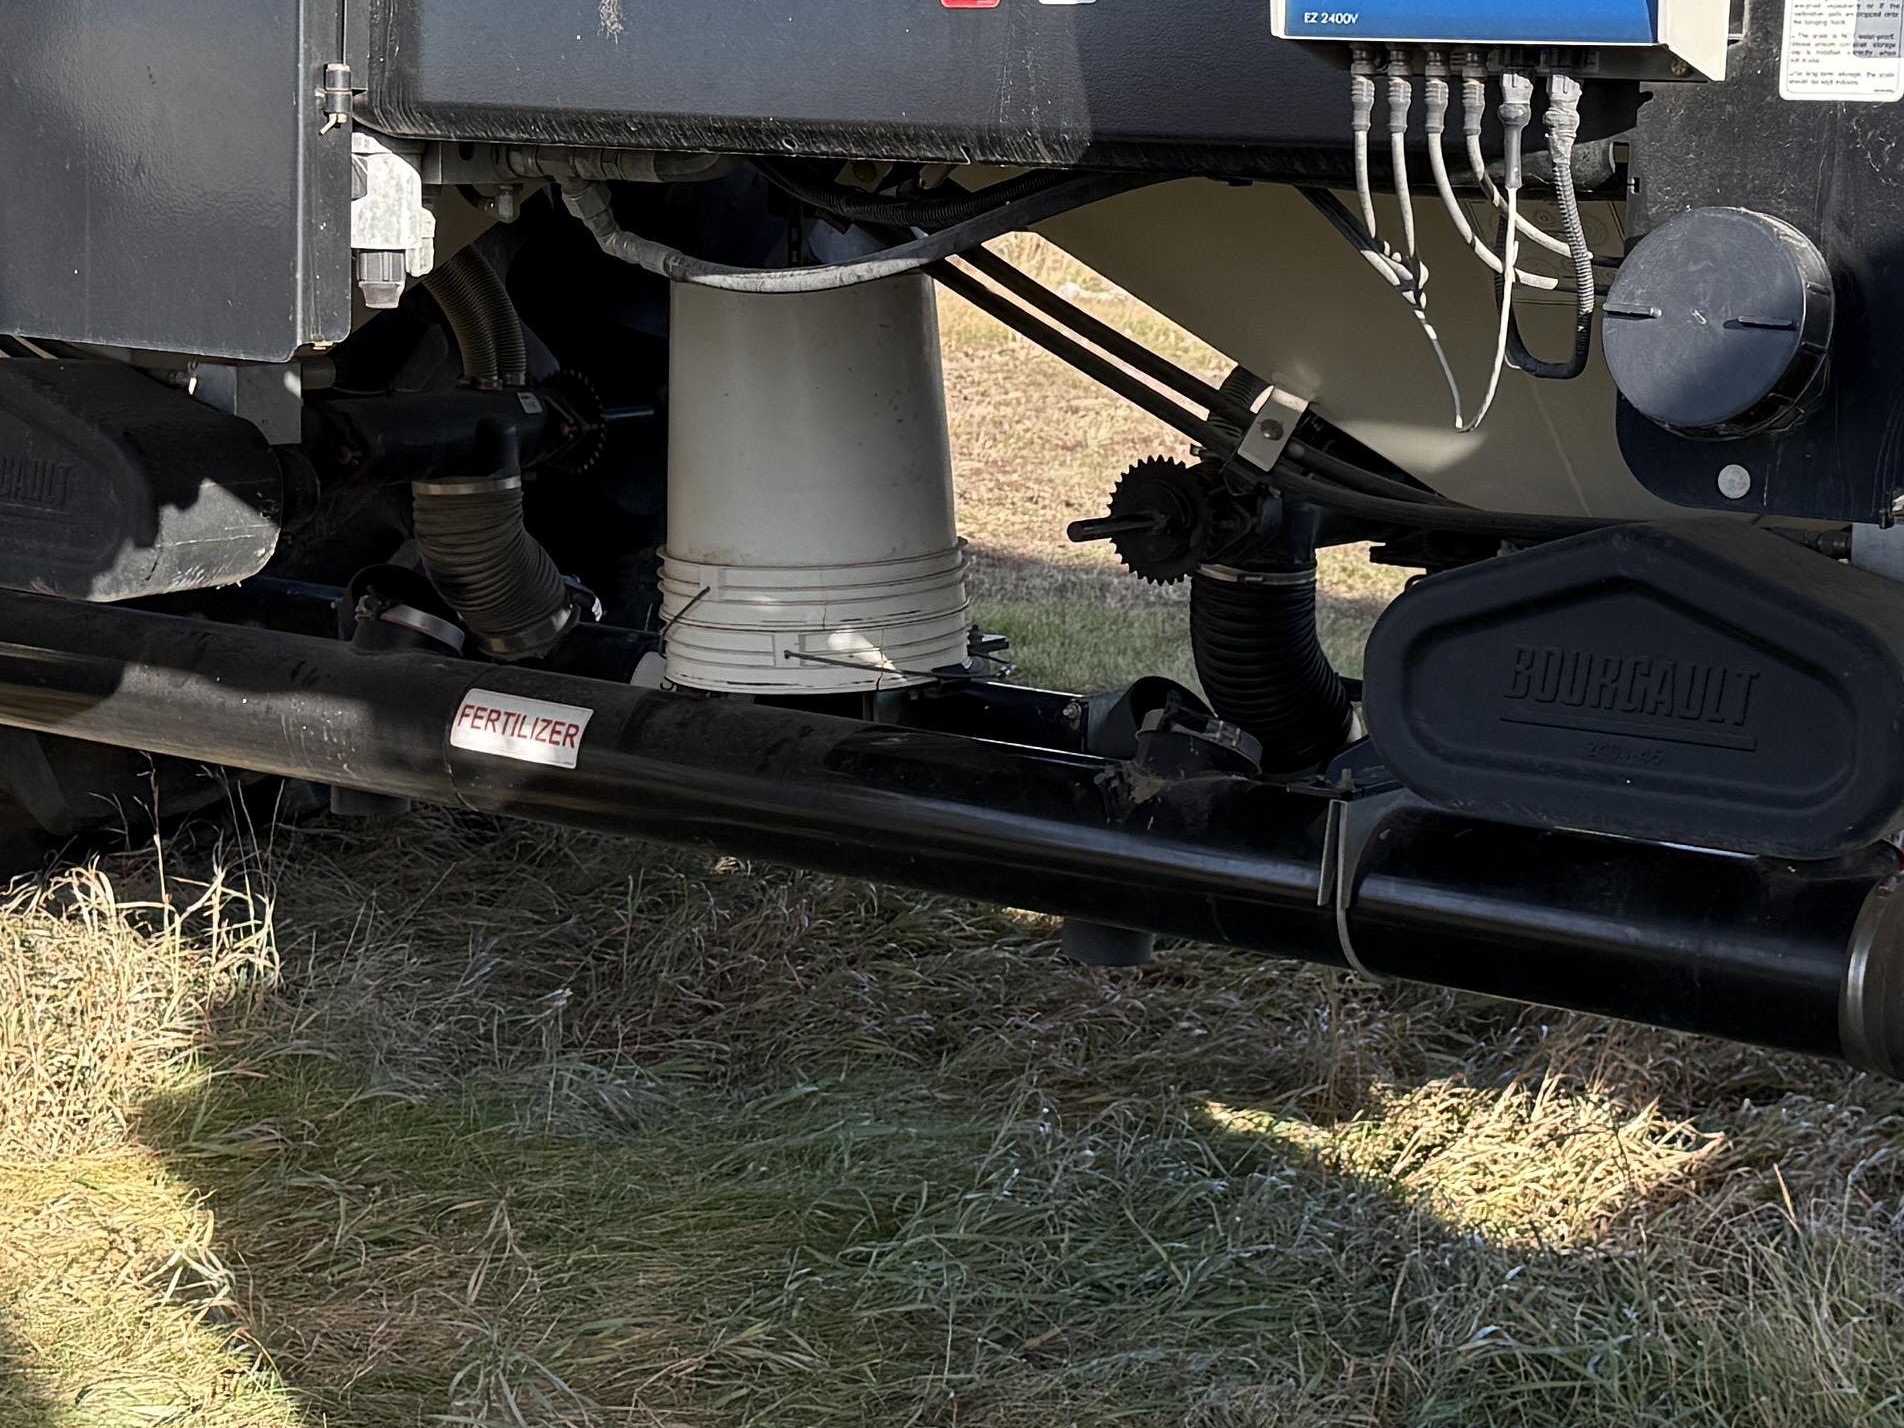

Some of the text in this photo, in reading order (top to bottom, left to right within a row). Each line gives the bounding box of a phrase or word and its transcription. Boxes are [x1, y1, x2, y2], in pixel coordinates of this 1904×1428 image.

[1304, 12, 1359, 25] EZ 2400V
[1503, 643, 1760, 727] BOURGAULT
[457, 704, 580, 749] FERTILIZER
